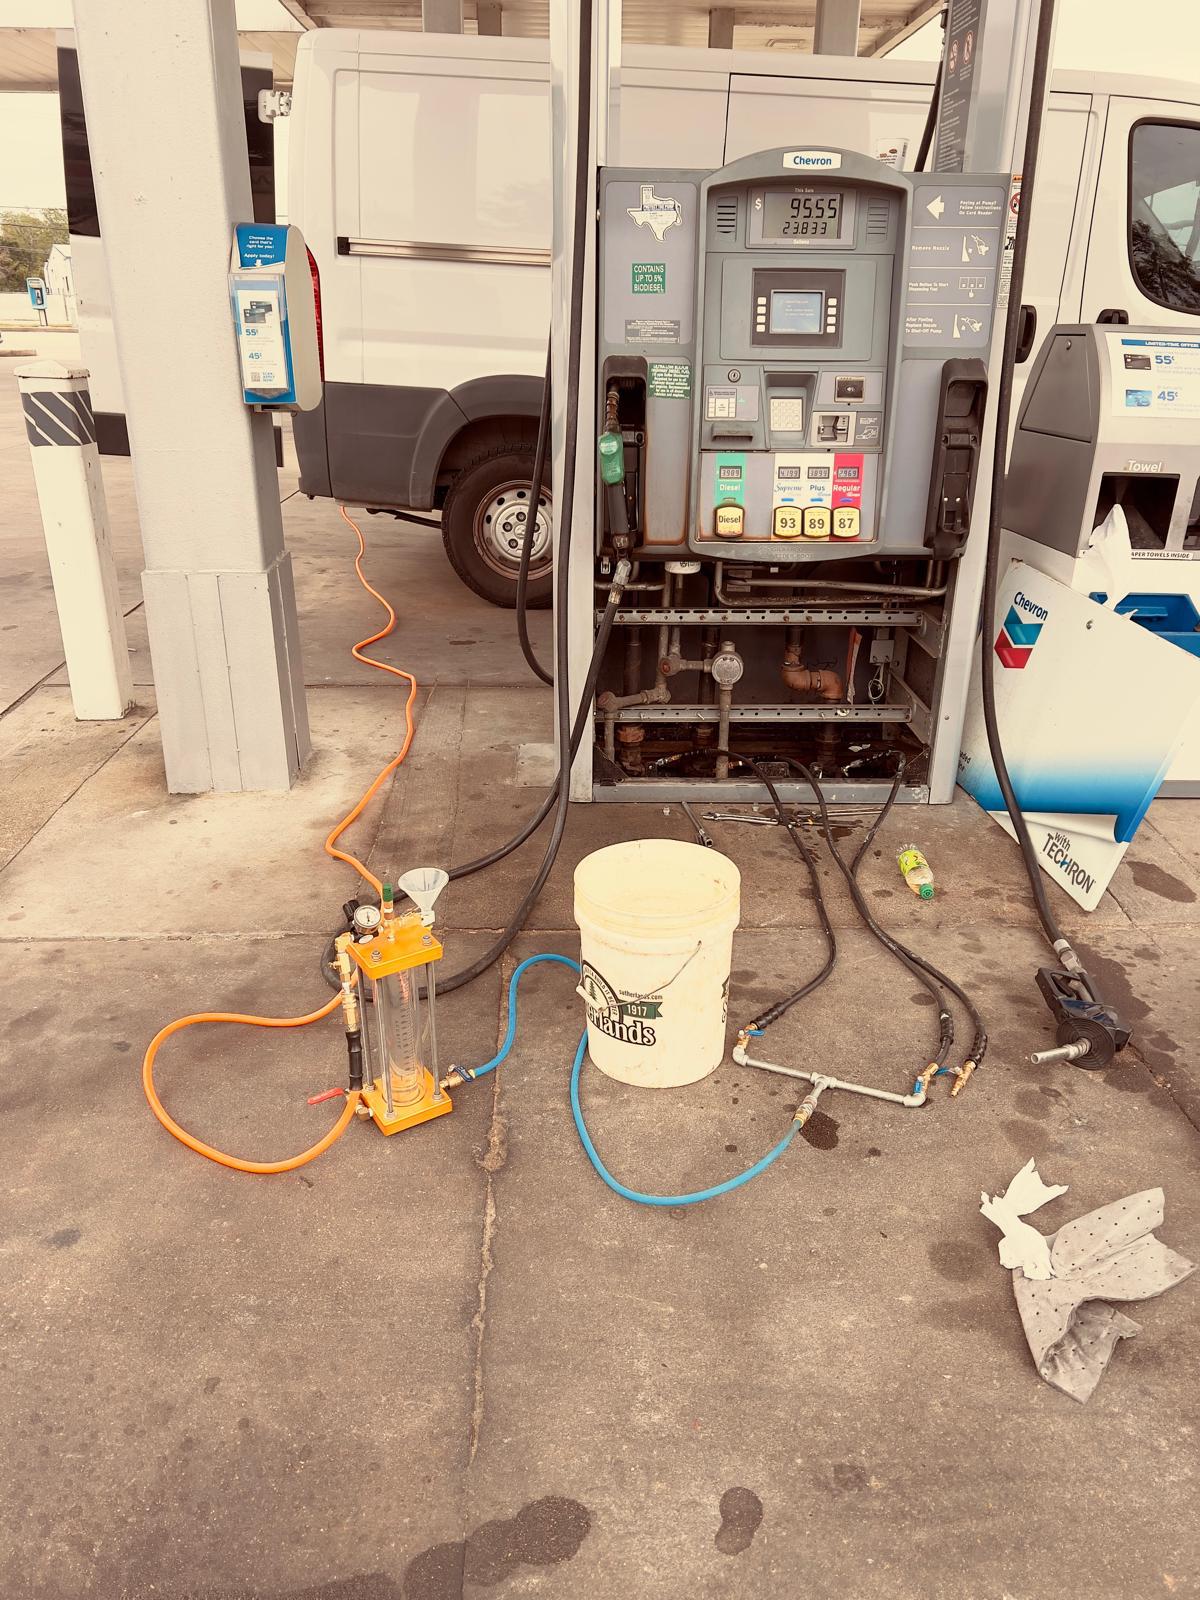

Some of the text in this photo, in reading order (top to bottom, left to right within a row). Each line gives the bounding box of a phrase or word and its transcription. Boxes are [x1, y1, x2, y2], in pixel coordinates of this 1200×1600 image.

[793, 156, 832, 165] Chevron
[755, 198, 762, 210] $
[791, 198, 837, 218] 95.55
[783, 222, 828, 234] 23.833
[633, 265, 664, 273] CONTAINS
[633, 284, 664, 292] BIODIESEL
[1154, 354, 1174, 365] 55¢
[1157, 389, 1178, 401] 45¢
[1128, 460, 1162, 472] Towel
[774, 484, 802, 492] Supreme
[809, 484, 826, 492] Plus
[833, 484, 861, 493] Regular
[718, 515, 741, 524] Diesel
[780, 517, 796, 528] 93
[809, 518, 825, 529] 89
[838, 518, 854, 529] 87
[1014, 592, 1048, 621] Chevron
[1054, 832, 1070, 852] with
[1042, 833, 1095, 894] TECHRON
[627, 1004, 648, 1017] 1917
